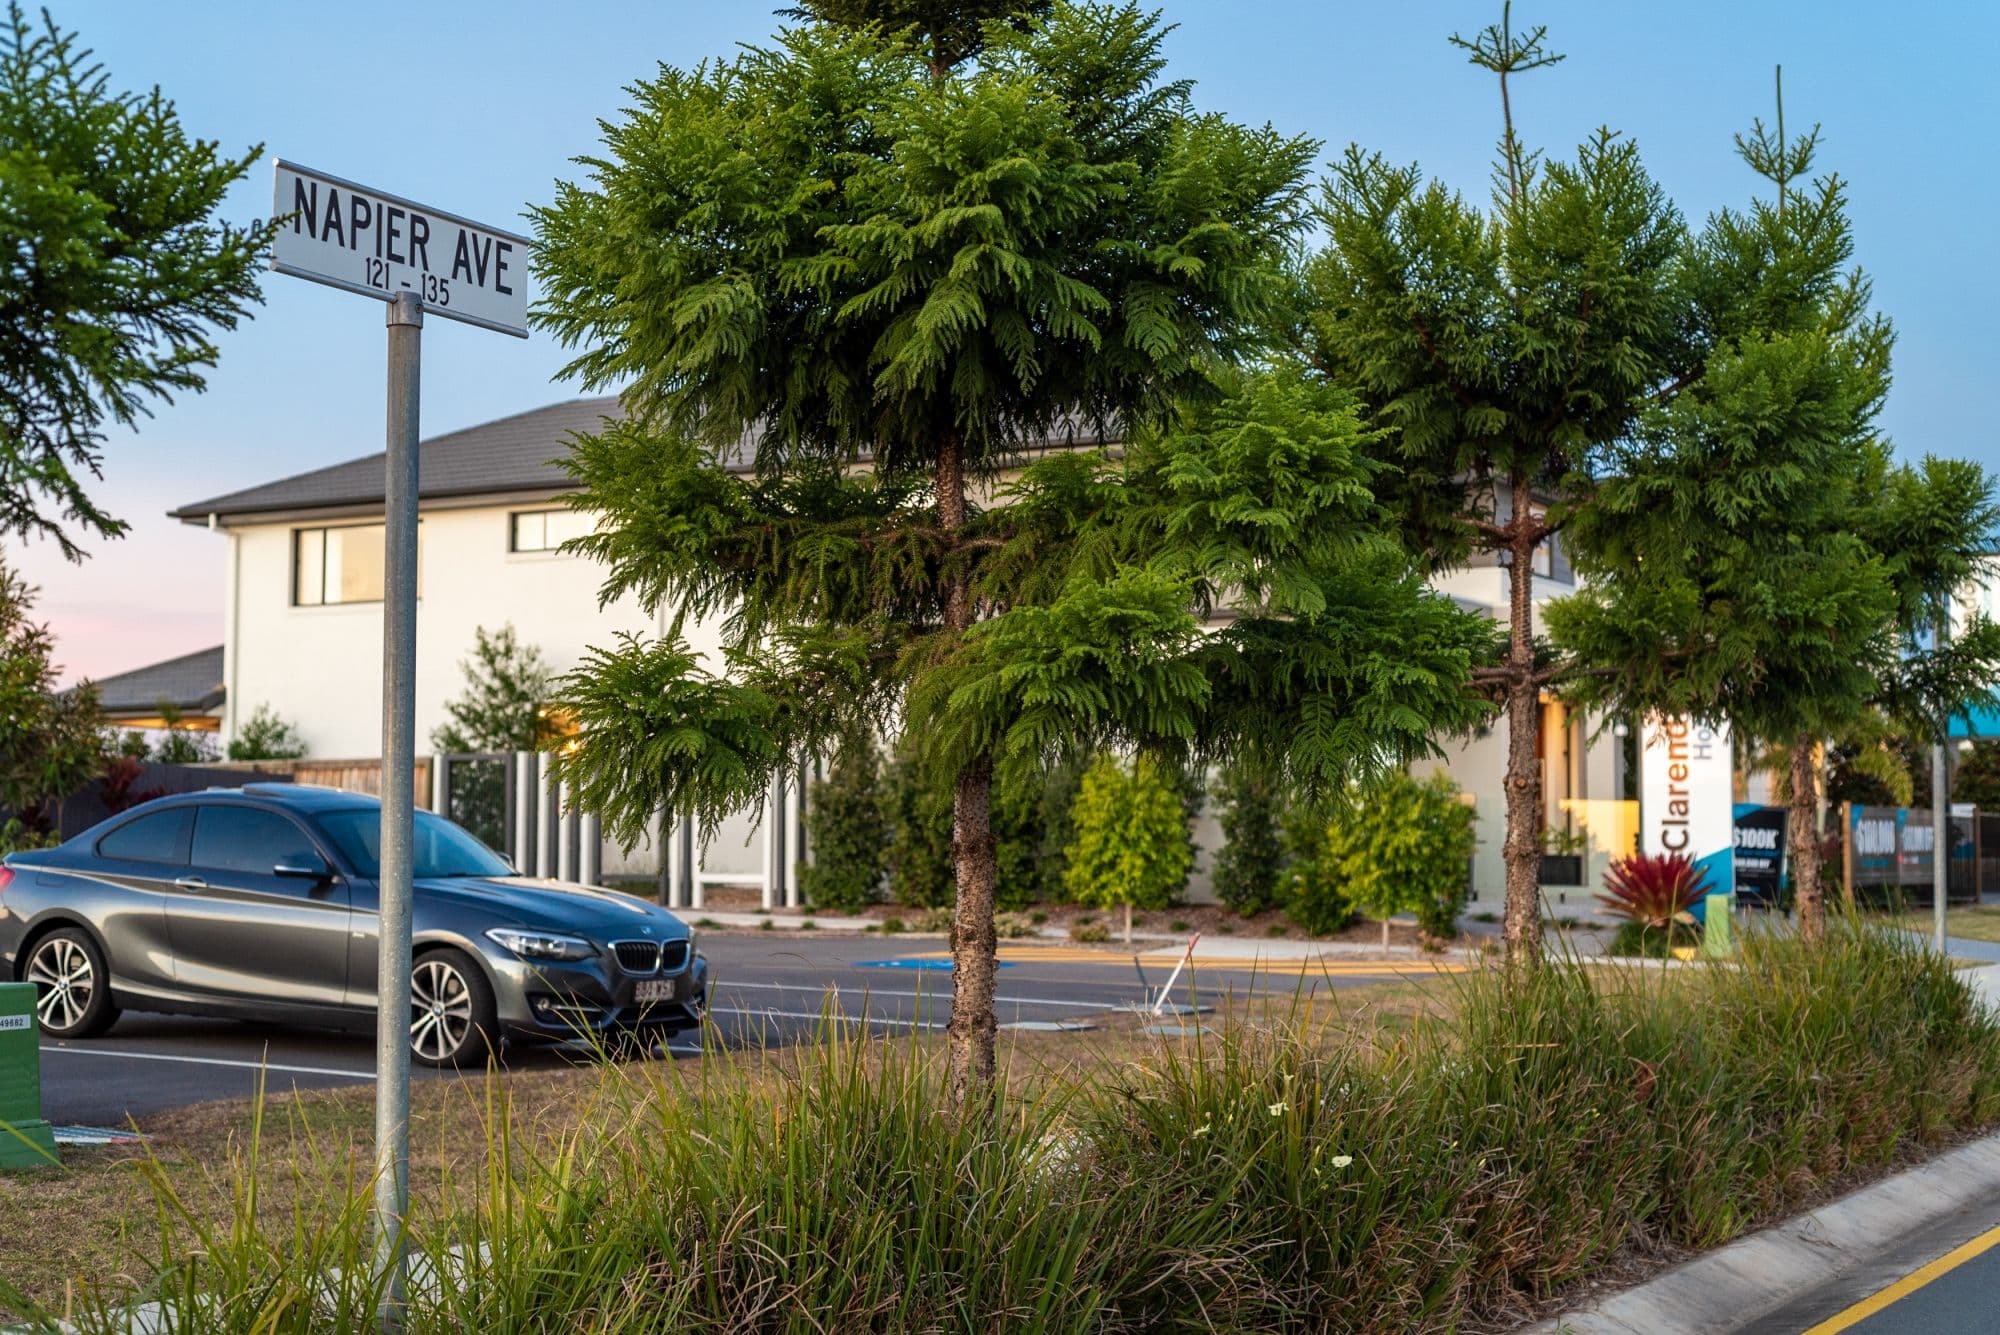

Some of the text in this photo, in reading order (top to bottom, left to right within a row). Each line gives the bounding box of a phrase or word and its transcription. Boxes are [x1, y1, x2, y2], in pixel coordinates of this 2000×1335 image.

[294, 177, 513, 296] NAPIER AVE
[366, 257, 390, 290] 121
[421, 273, 450, 306] 135
[1661, 719, 1690, 852] Clarend
